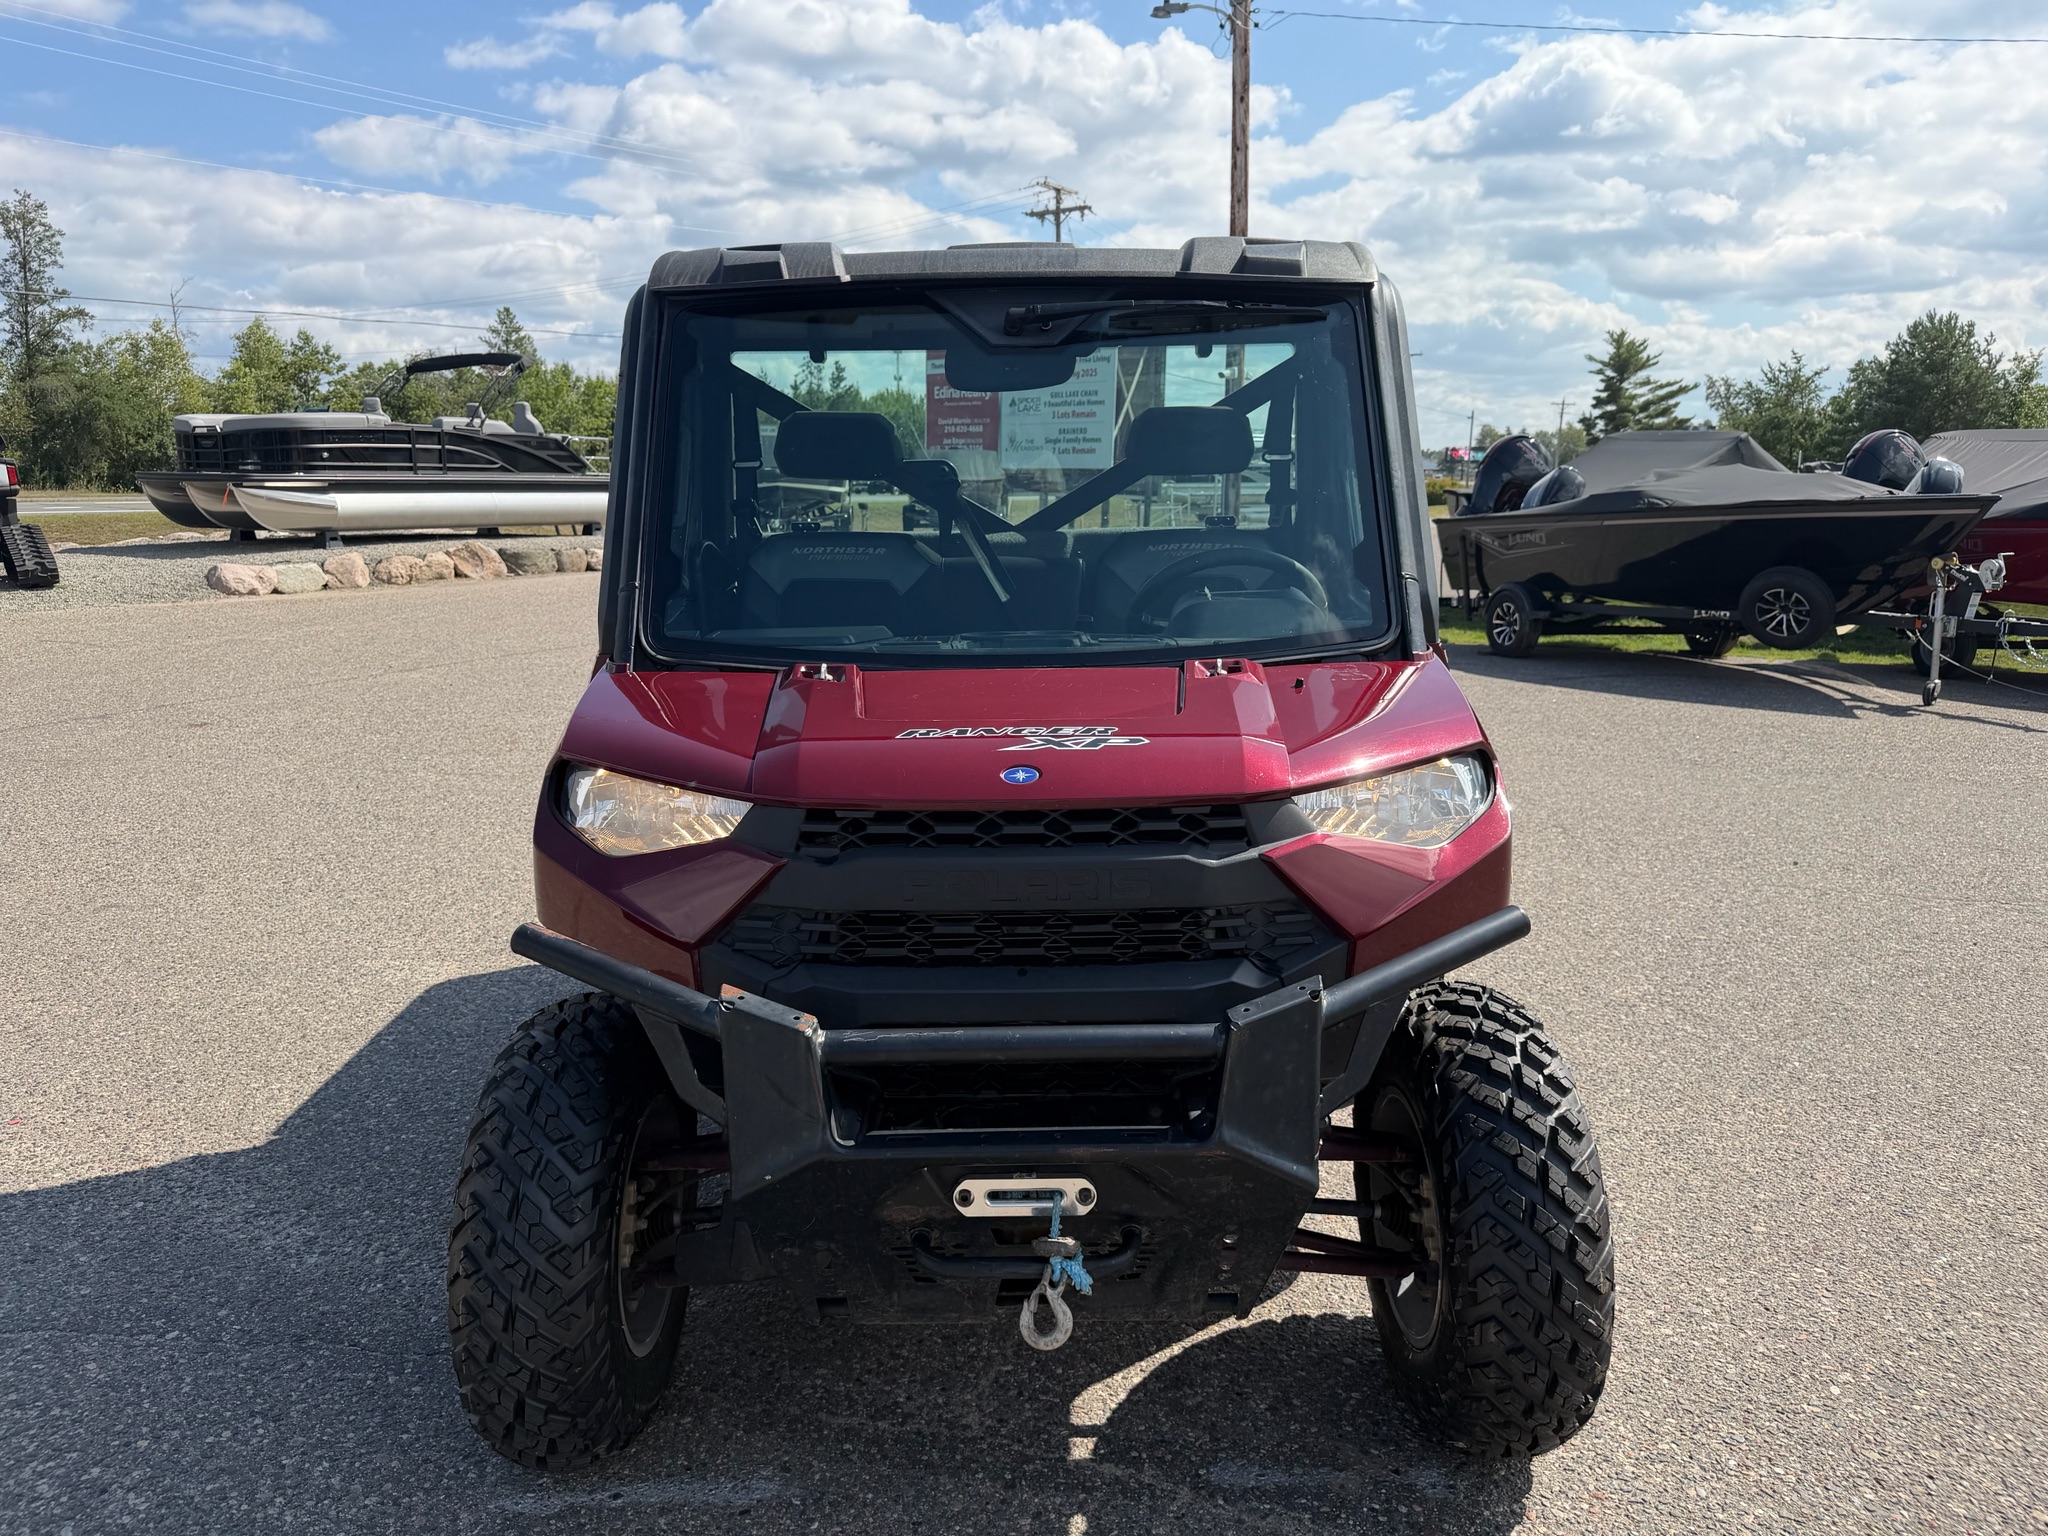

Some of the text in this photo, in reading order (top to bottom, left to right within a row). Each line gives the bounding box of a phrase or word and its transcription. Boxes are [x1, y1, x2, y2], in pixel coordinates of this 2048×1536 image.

[1081, 368, 1097, 378] 2025
[1065, 390, 1079, 398] LAKE
[1080, 389, 1098, 397] CHAIN
[1017, 403, 1041, 412] LAKE
[1073, 399, 1085, 407] Lake
[1057, 410, 1071, 418] Lots
[1072, 408, 1096, 417] Remain
[1058, 427, 1087, 435] BRAINERD
[1062, 436, 1081, 445] Family
[1058, 446, 1071, 454] Lots
[1072, 446, 1096, 454] Remain
[1508, 532, 1546, 547] LUND
[791, 546, 887, 554] NORTHSTAR
[1693, 609, 1731, 620] LUND
[895, 726, 1118, 739] RANGER
[996, 736, 1150, 752] XP
[901, 868, 1153, 901] POLARIS
